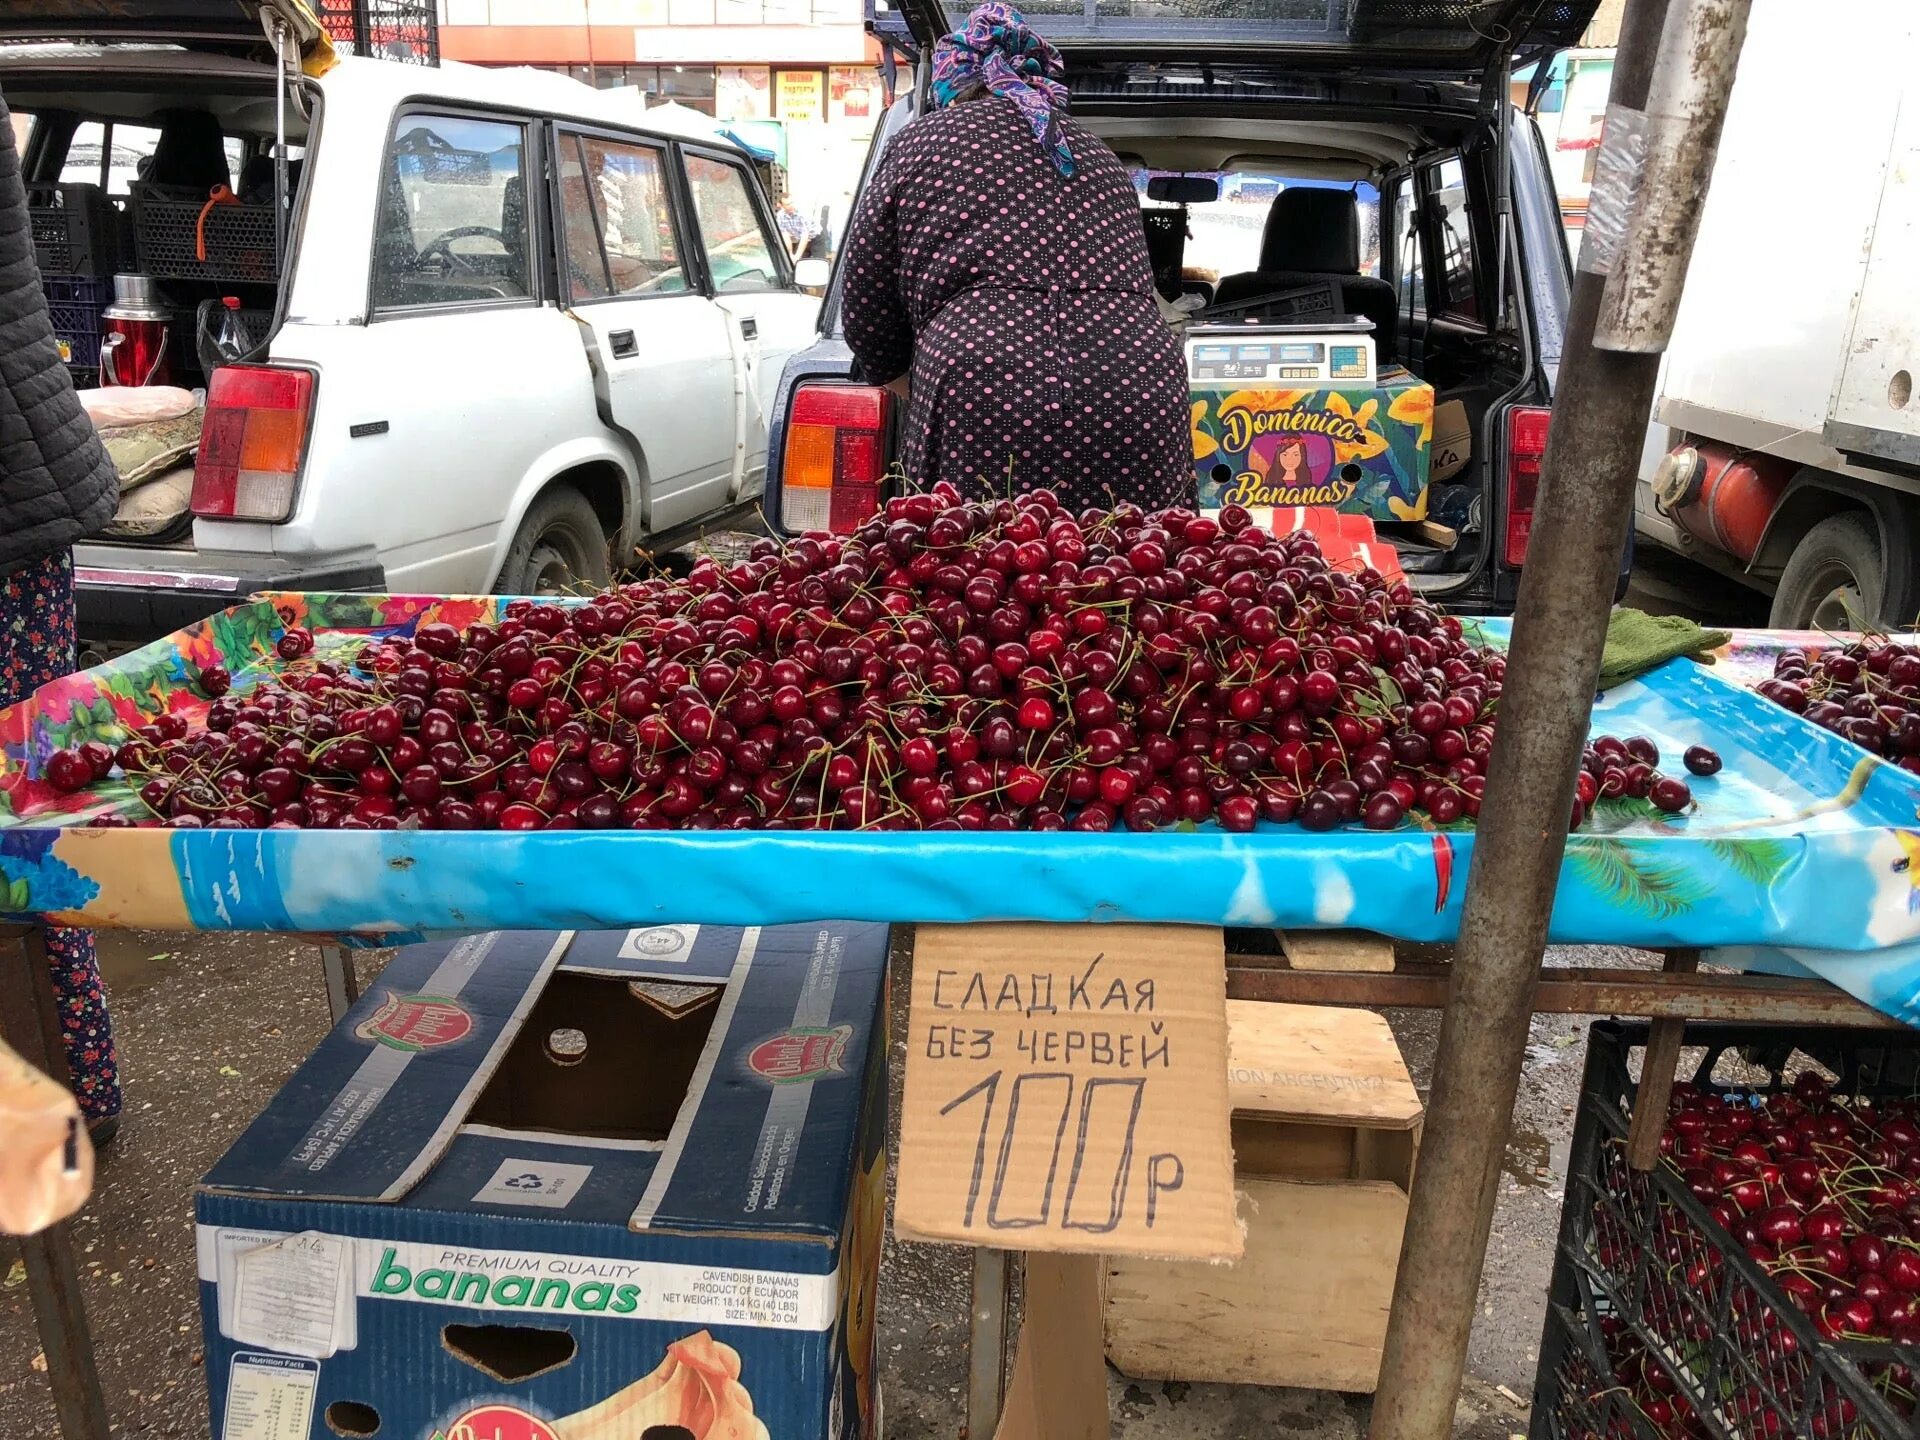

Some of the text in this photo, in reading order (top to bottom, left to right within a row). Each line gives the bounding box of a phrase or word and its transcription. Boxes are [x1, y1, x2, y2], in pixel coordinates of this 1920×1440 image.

[1225, 472, 1348, 506] Bananas
[933, 952, 1155, 1018] СЛАДКАЯ
[764, 1036, 811, 1074] Dakota
[927, 1021, 1169, 1069] БЕЗ ЧЕРВЕЙ
[1229, 1069, 1266, 1084] ION
[308, 1087, 385, 1171] THIABENDAZOLE APPLIED
[744, 1125, 778, 1213] Calidad Seleccionada
[764, 1127, 796, 1210] Paletizado en Origen
[225, 1234, 261, 1243] IMPORTED
[370, 1247, 642, 1314] bananas
[440, 1251, 640, 1279] PREMIUM QUALITY
[703, 1271, 799, 1287] CAVENDISH BANANAS
[663, 1293, 798, 1313] NET WEIGHT: 18.14 KG (40 LBS)
[693, 1283, 799, 1300] PRODUCT OF ECUADOR
[725, 1309, 798, 1324] SIZE: MIN. 20 CM
[248, 1356, 305, 1369] Nutrition Facts
